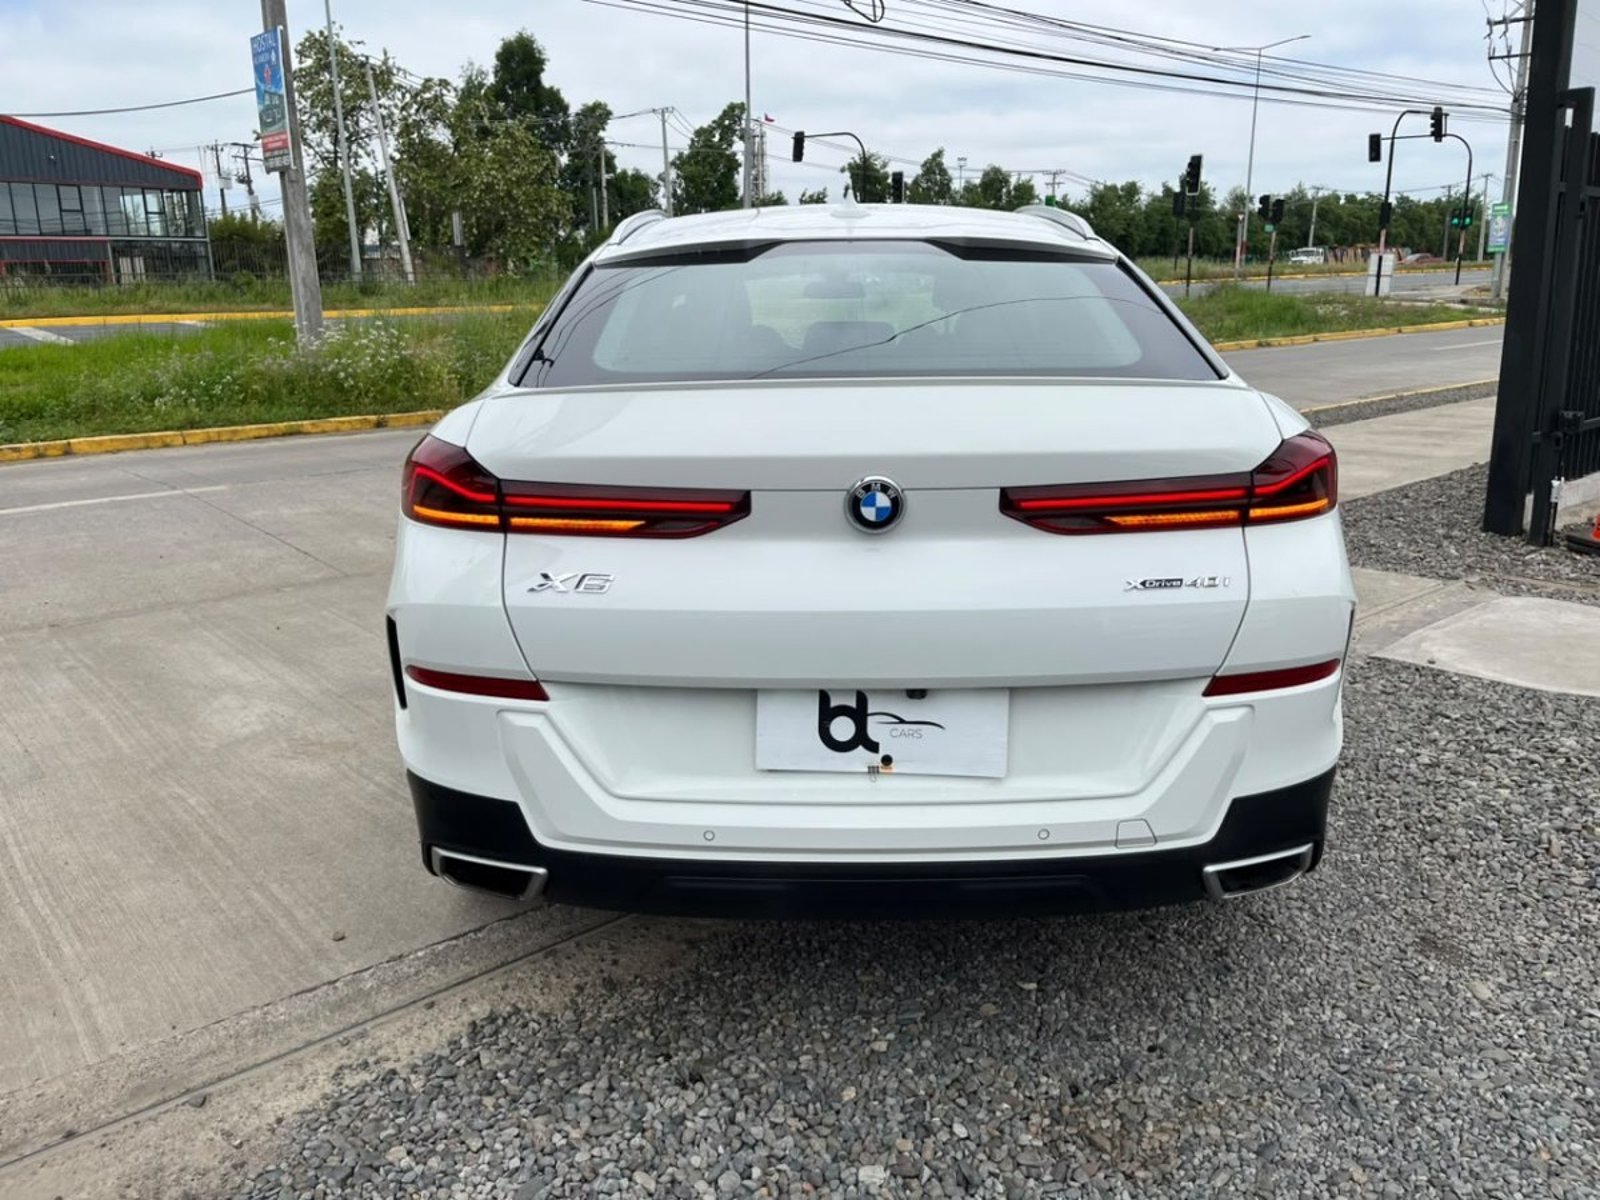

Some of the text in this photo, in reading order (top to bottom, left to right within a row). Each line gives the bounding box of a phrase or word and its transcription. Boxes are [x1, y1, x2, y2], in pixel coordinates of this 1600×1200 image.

[855, 483, 897, 499] BMW
[526, 571, 615, 594] X6
[889, 727, 923, 740] CARS
